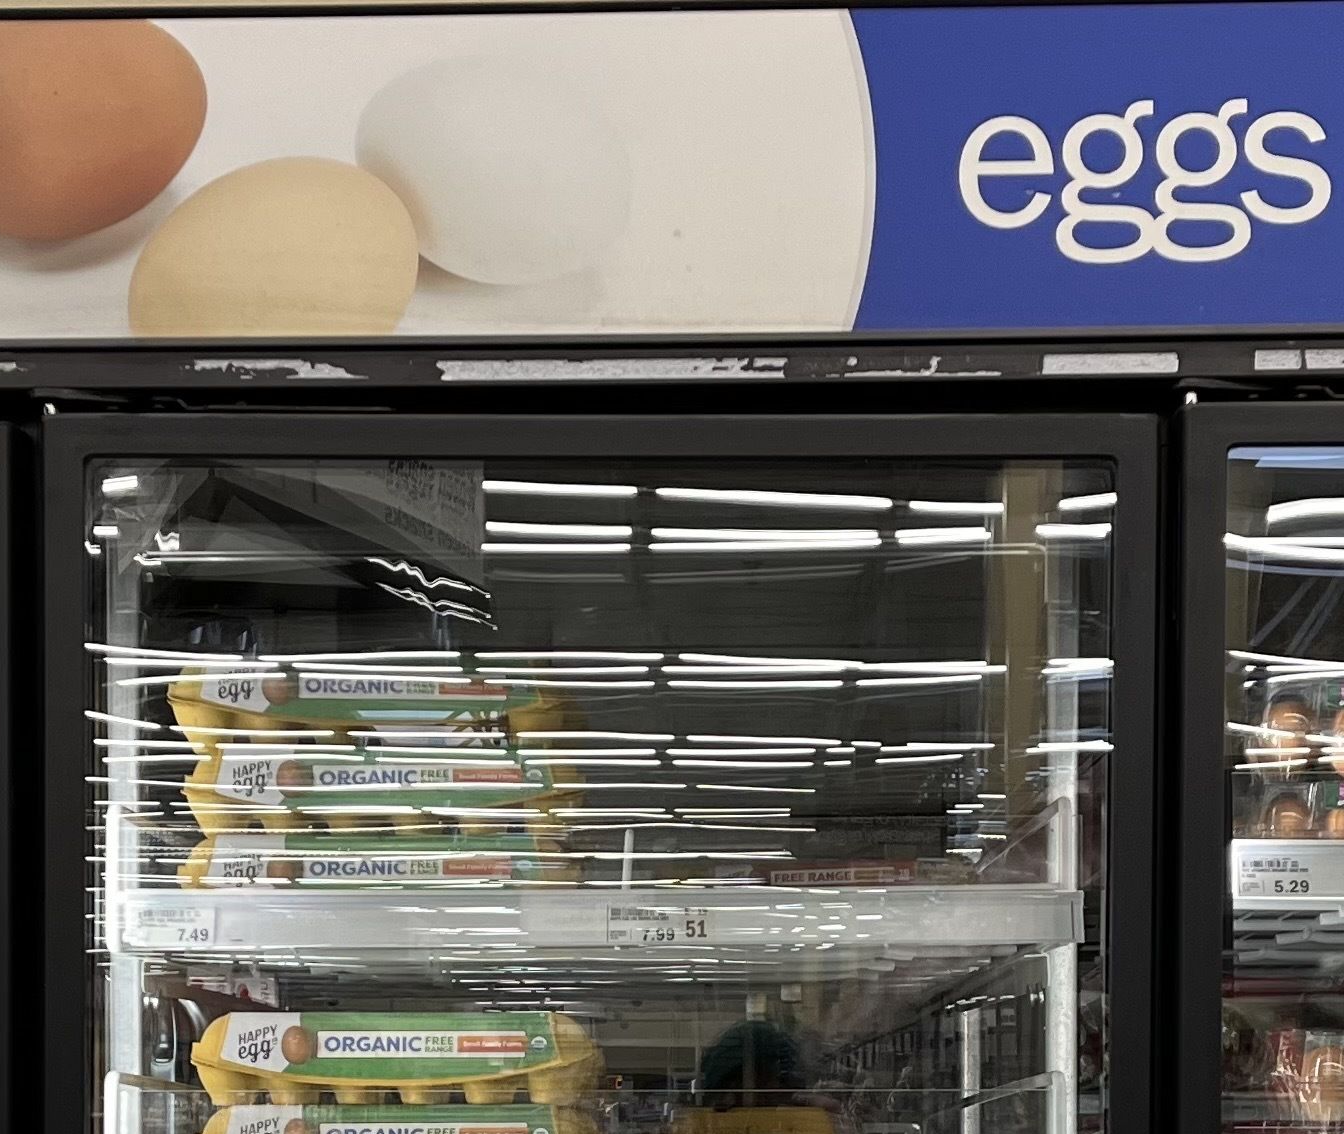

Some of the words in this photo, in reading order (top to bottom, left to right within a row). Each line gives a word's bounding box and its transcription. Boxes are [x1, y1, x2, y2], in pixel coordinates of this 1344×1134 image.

[958, 98, 1332, 264] eggs
[218, 678, 254, 702] egg
[306, 678, 404, 694] ORGANIC
[232, 760, 272, 778] HAPPY
[420, 768, 450, 778] FREE
[232, 774, 268, 796] egg
[319, 770, 418, 786] ORGANIC
[309, 860, 408, 876] ORGANIC
[410, 860, 440, 869] FREE
[808, 871, 851, 882] RANGE
[1274, 880, 1310, 893] 5.29
[177, 928, 209, 942] 7.49
[686, 920, 708, 938] 51
[238, 1024, 278, 1045] HAPPY
[424, 1036, 454, 1046] FREE
[238, 1038, 274, 1063] egg
[324, 1036, 422, 1052] ORGANIC
